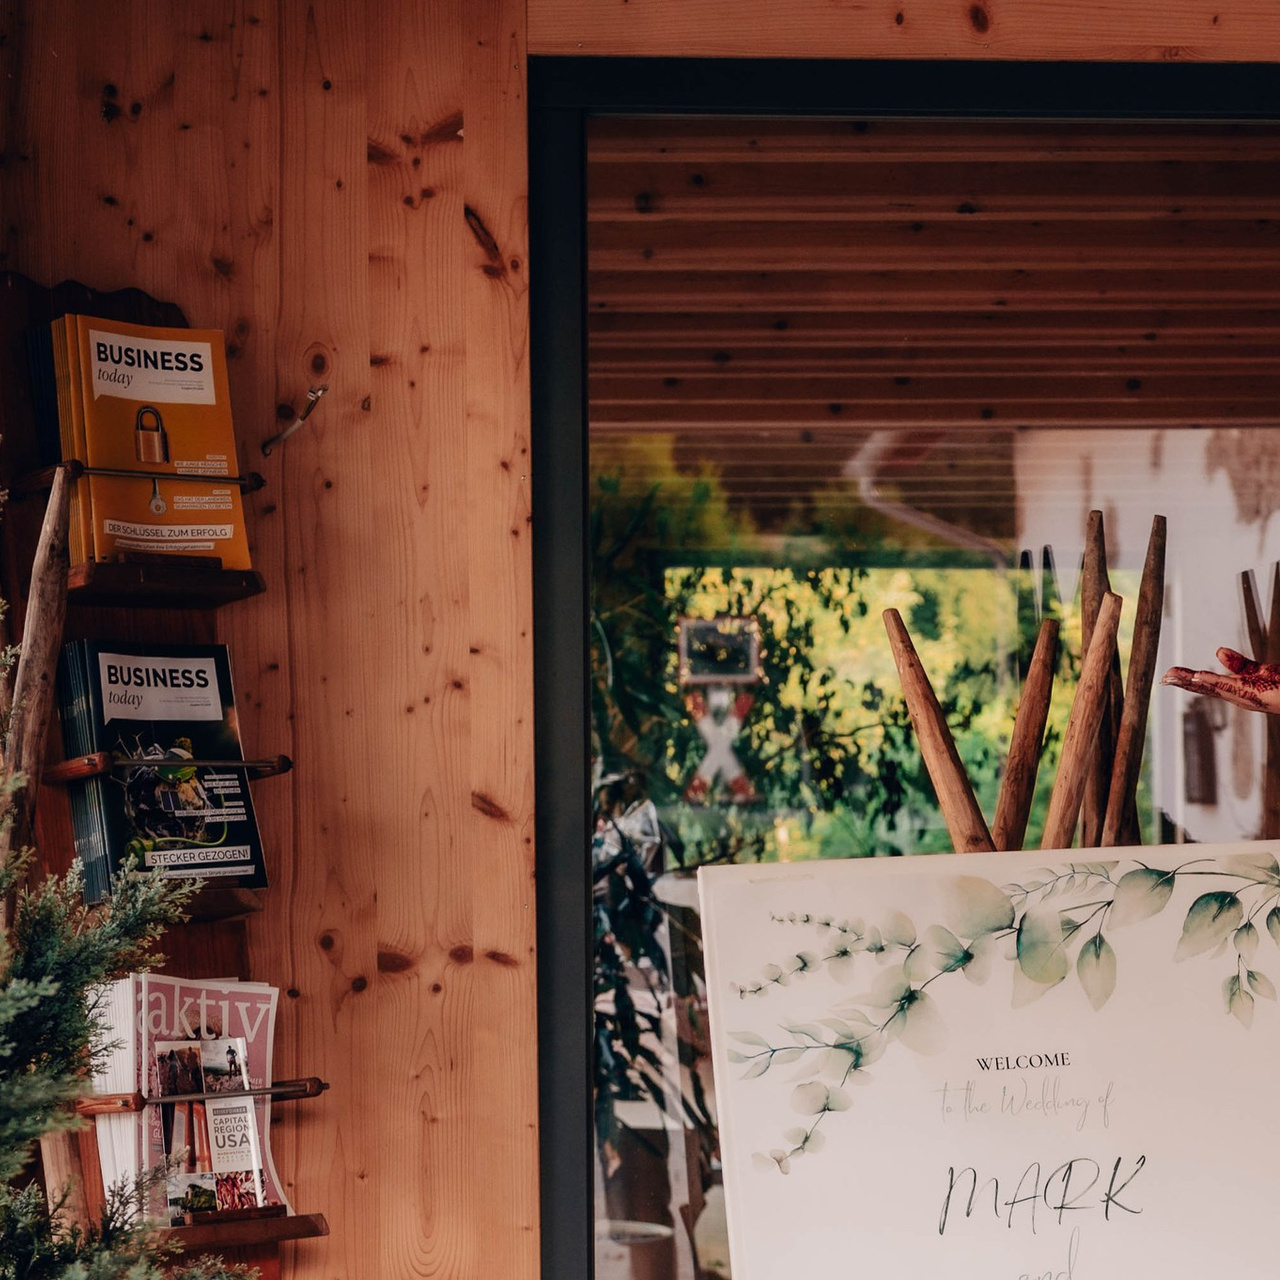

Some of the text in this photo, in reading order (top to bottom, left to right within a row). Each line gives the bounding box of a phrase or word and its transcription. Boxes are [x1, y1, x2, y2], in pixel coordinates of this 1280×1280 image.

[96, 342, 204, 372] BUSINESS
[97, 368, 133, 389] today
[108, 523, 228, 537] DER SCHLÜSSEL ZUM ERFOLG
[107, 664, 209, 688] BUSINESS
[108, 690, 143, 709] today
[150, 849, 249, 864] STECKER GEZOGEN!
[147, 982, 271, 1043] aktiv
[976, 1052, 1071, 1071] WELCOME
[931, 1075, 1116, 1132] to the Wedding of
[213, 1116, 249, 1126] CAPITAL
[214, 1124, 249, 1134] REGION
[215, 1133, 251, 1149] USA
[938, 1154, 1147, 1236] MARK
